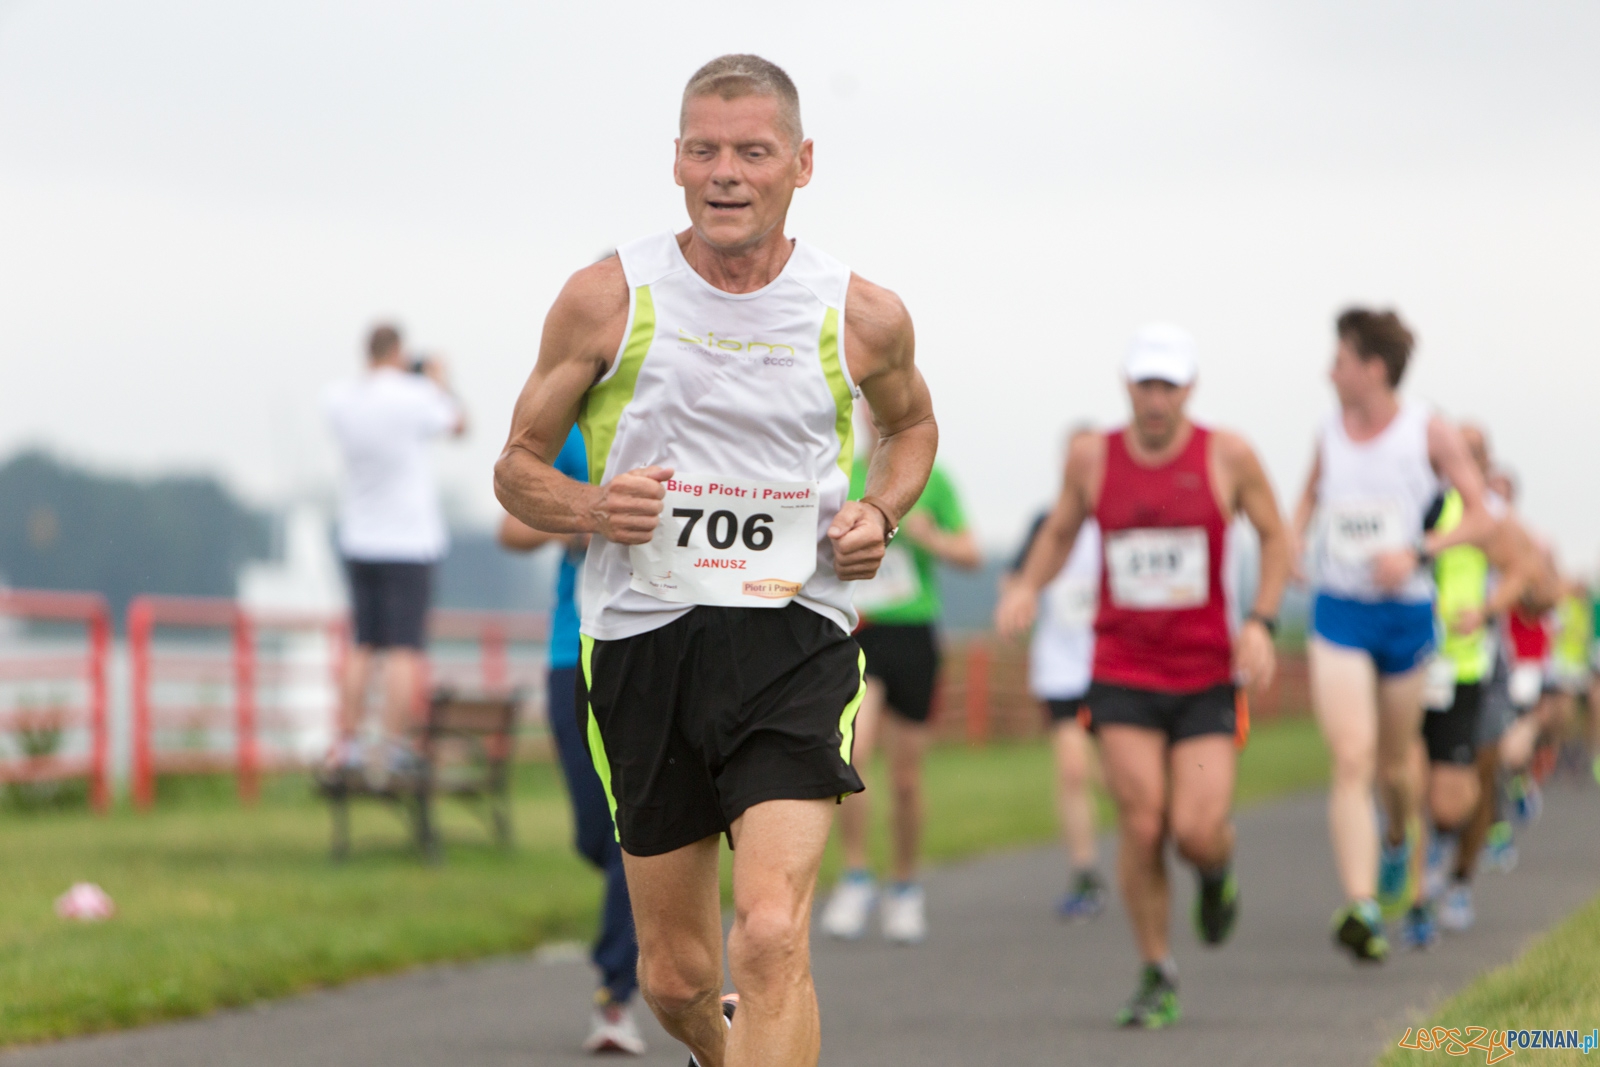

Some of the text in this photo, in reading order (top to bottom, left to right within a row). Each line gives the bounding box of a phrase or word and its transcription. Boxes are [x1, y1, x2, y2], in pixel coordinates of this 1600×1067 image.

[715, 352, 746, 362] MOT
[763, 356, 794, 367] ecco
[666, 479, 811, 500] Bieg Piotr i Paweł
[672, 507, 775, 551] 706
[694, 558, 747, 570] JANUSZ
[744, 583, 767, 592] Piotr
[768, 584, 772, 592] i
